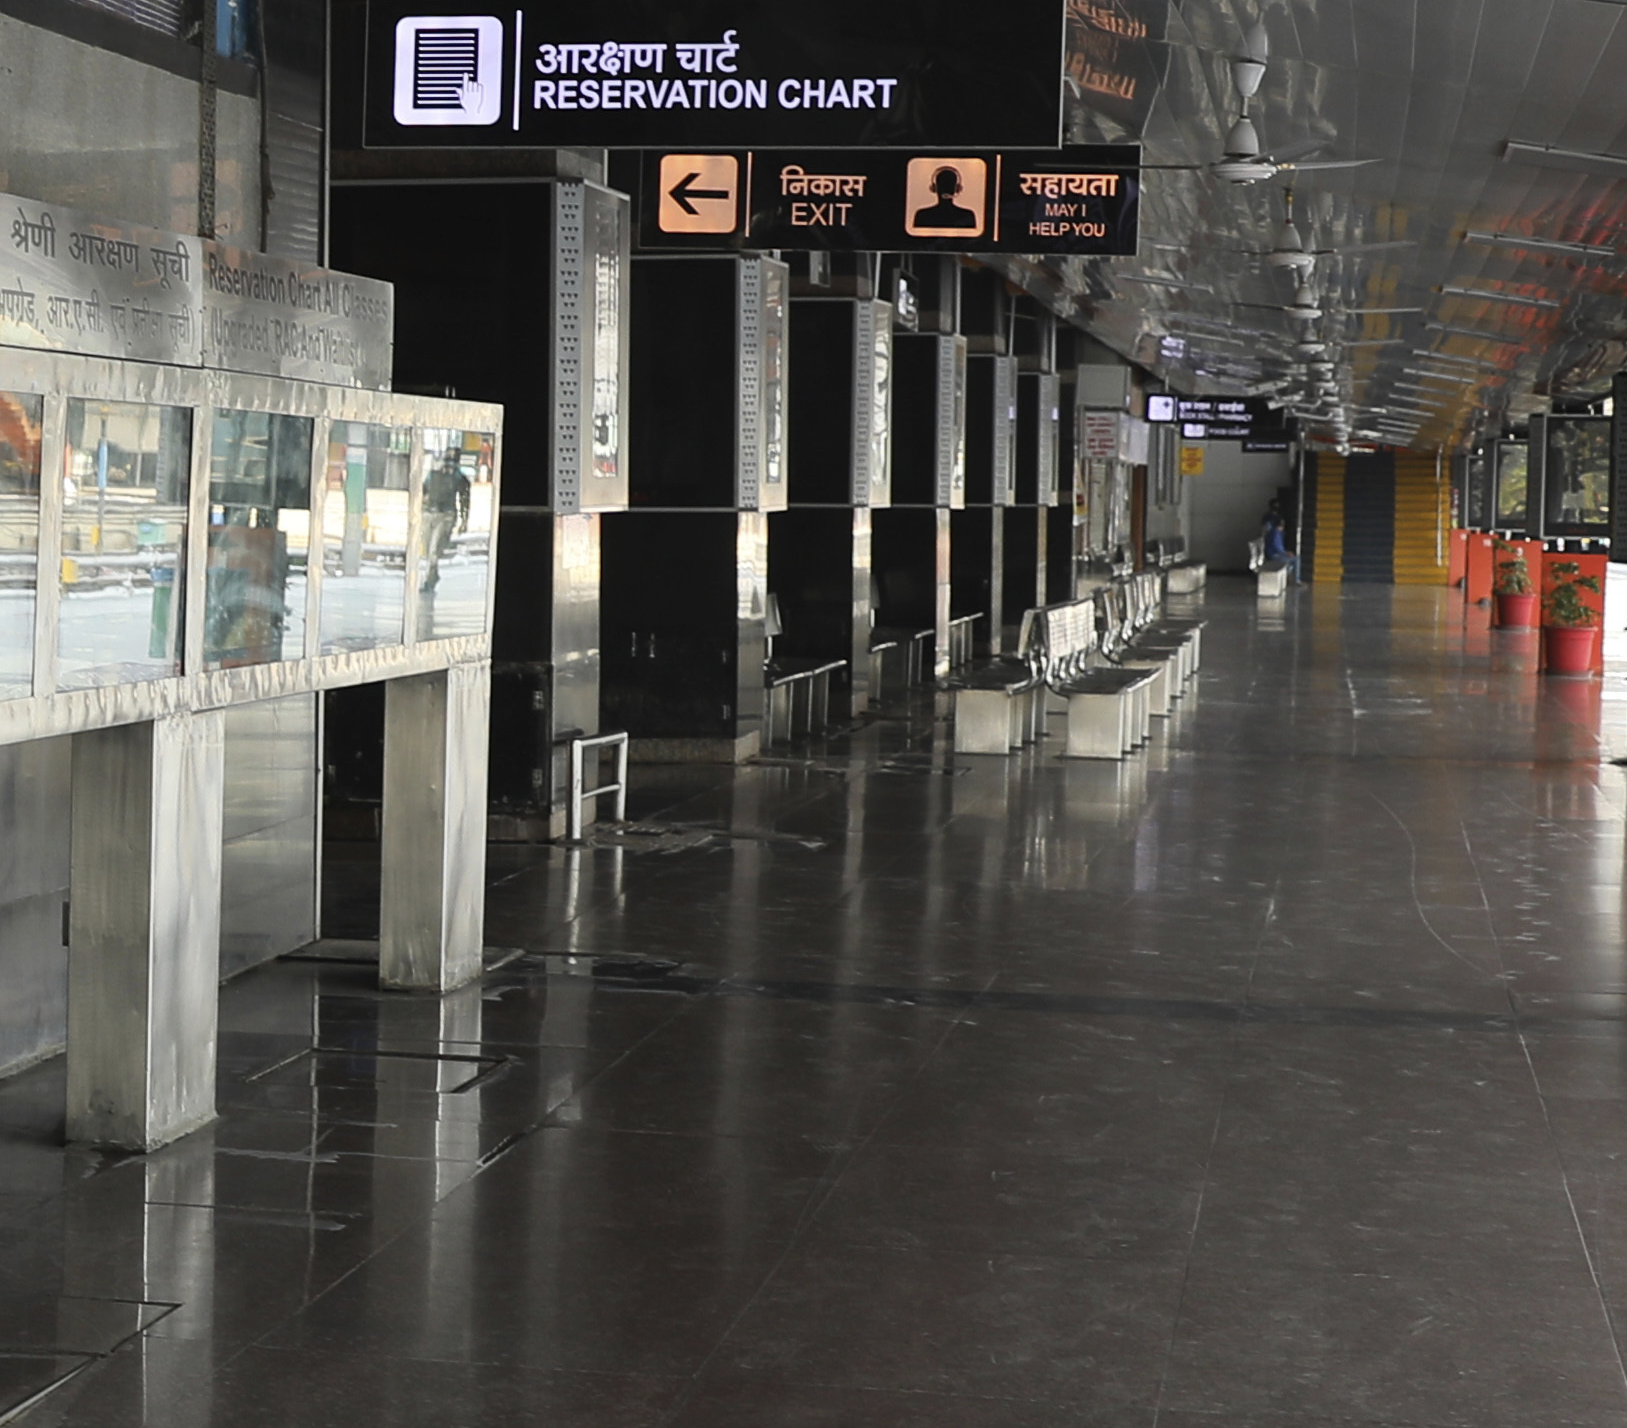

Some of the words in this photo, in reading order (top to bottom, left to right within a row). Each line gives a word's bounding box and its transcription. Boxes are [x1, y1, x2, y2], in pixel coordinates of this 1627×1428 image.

[535, 41, 668, 76] आरक्षण
[675, 29, 740, 73] चार्ट
[533, 79, 768, 109] RESERVATION
[777, 79, 898, 109] CHART
[780, 165, 867, 197] निकास
[1019, 173, 1120, 198] सहायता
[791, 202, 853, 227] EXIT
[1045, 204, 1078, 217] MAY
[1081, 204, 1087, 217] I
[1029, 223, 1071, 237] HELP
[1073, 224, 1106, 238] YOU
[11, 207, 56, 258] श्रेणी
[68, 231, 140, 273] आरक्षण
[150, 240, 191, 290] सूची
[209, 252, 286, 305] Reservation
[288, 271, 322, 313] Chart
[324, 279, 338, 316] All
